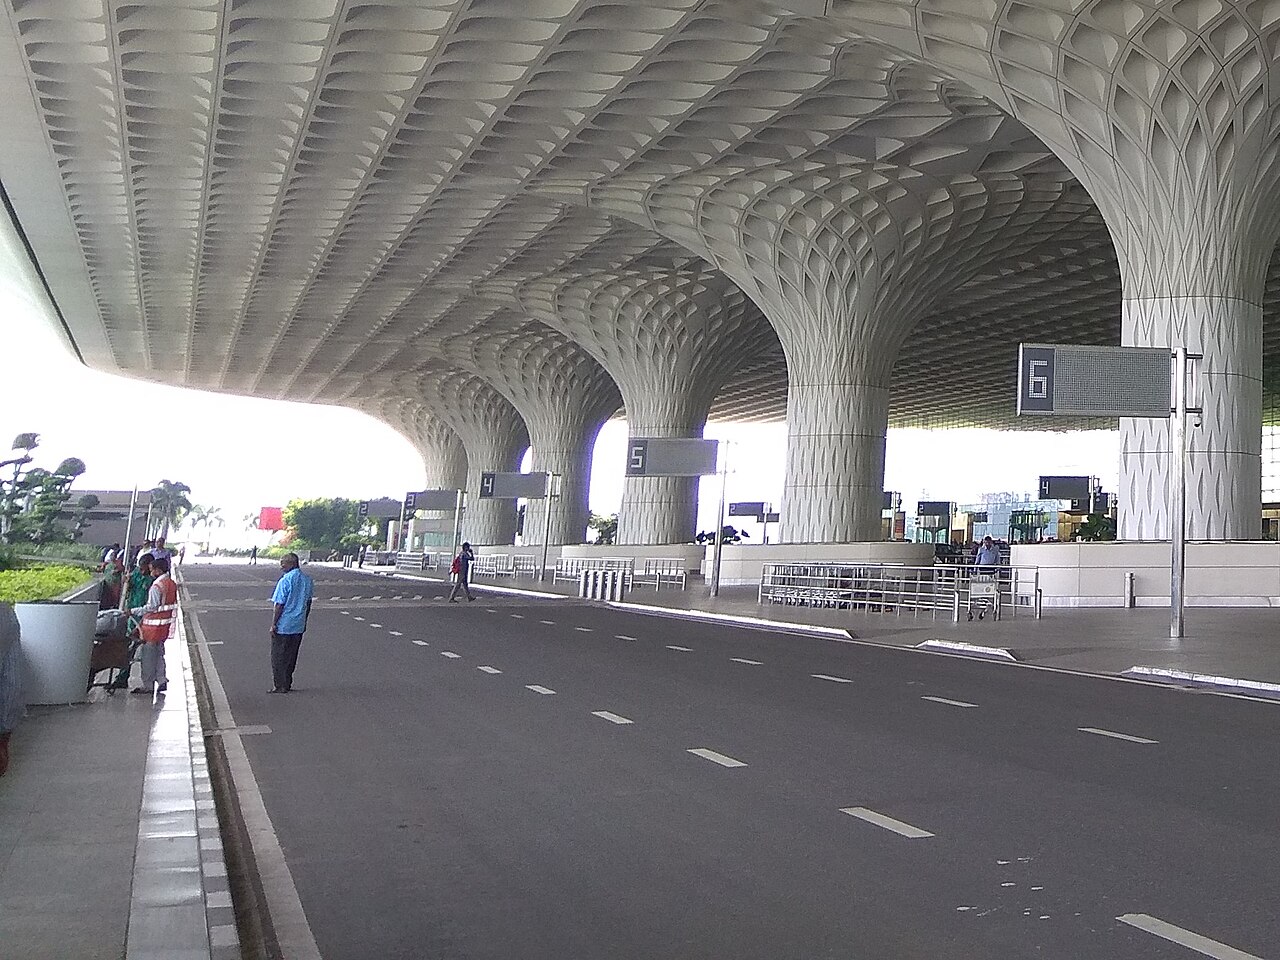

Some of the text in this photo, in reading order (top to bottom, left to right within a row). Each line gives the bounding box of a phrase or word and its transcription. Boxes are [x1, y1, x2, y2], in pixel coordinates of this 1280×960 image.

[1029, 360, 1048, 398] 6
[630, 446, 644, 468] 5
[483, 477, 493, 493] 4
[1042, 480, 1049, 495] 4
[407, 494, 415, 507] 3
[360, 503, 368, 514] 2
